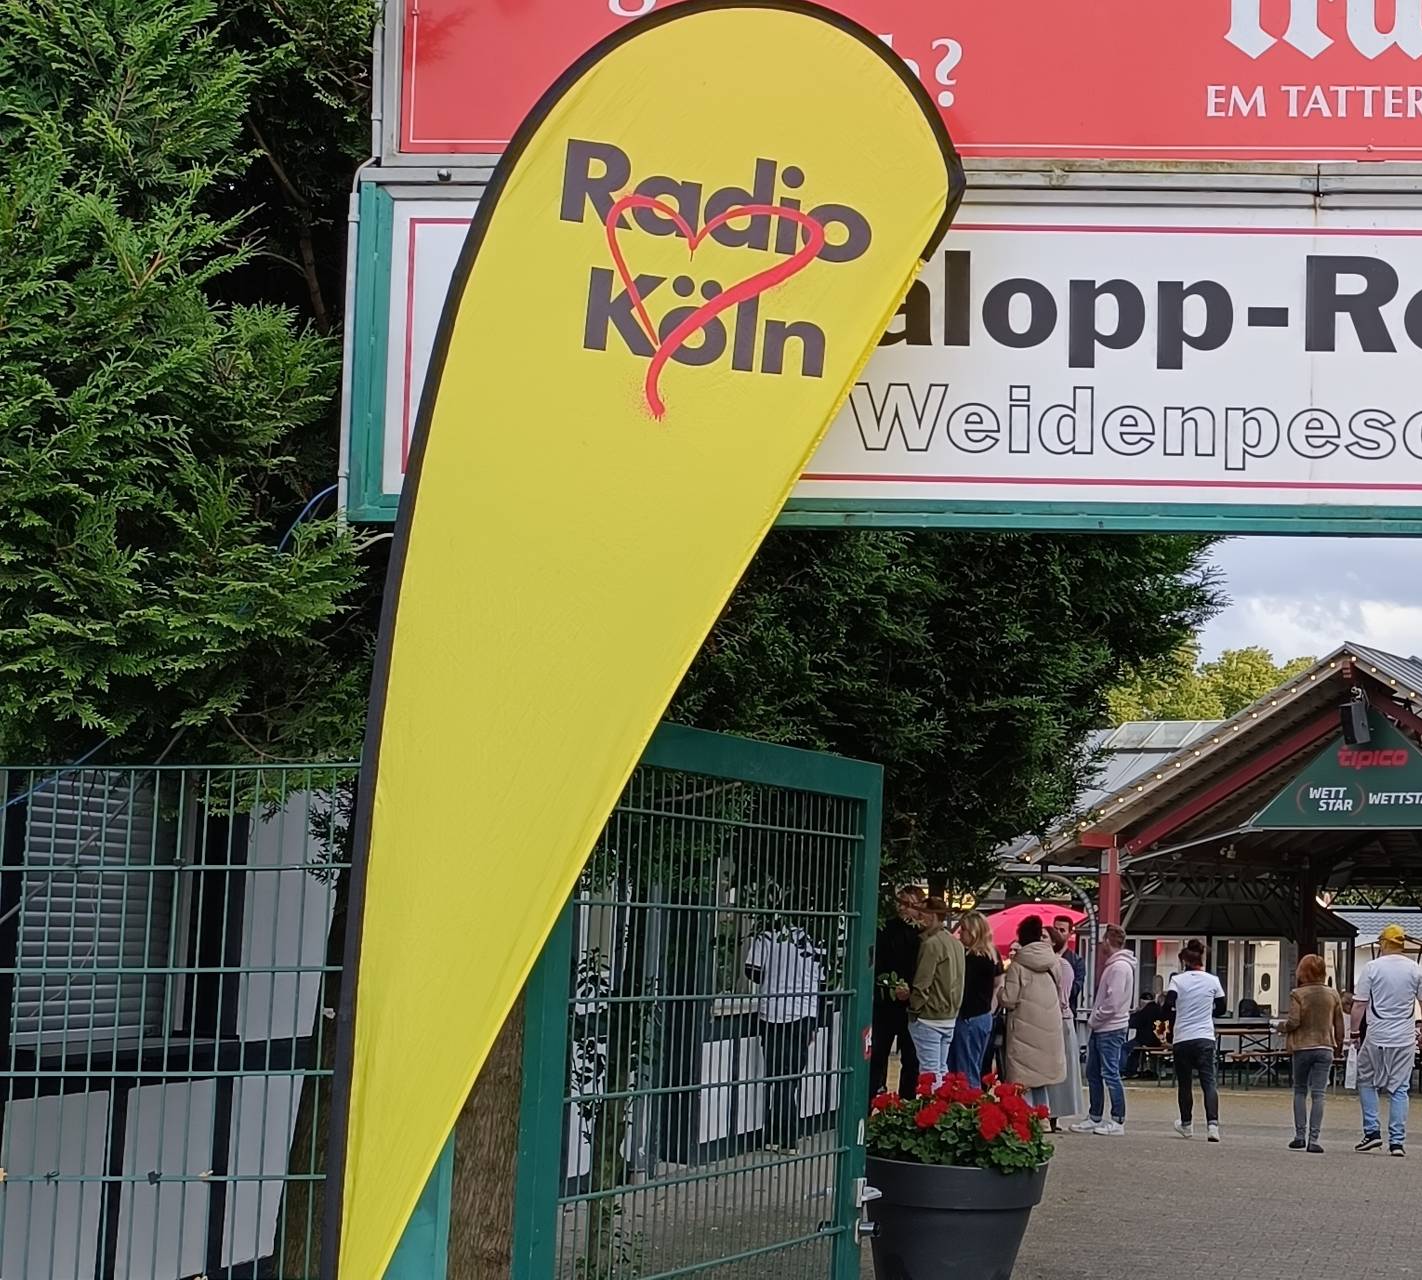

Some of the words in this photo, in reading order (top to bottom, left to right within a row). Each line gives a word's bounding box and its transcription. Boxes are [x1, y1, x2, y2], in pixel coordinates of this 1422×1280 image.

[1206, 85, 1267, 118] EM
[560, 138, 872, 263] Radio
[583, 266, 826, 378] Köln
[1337, 745, 1409, 770] tipico
[1309, 787, 1347, 799] WETT
[1318, 799, 1353, 811] STAR
